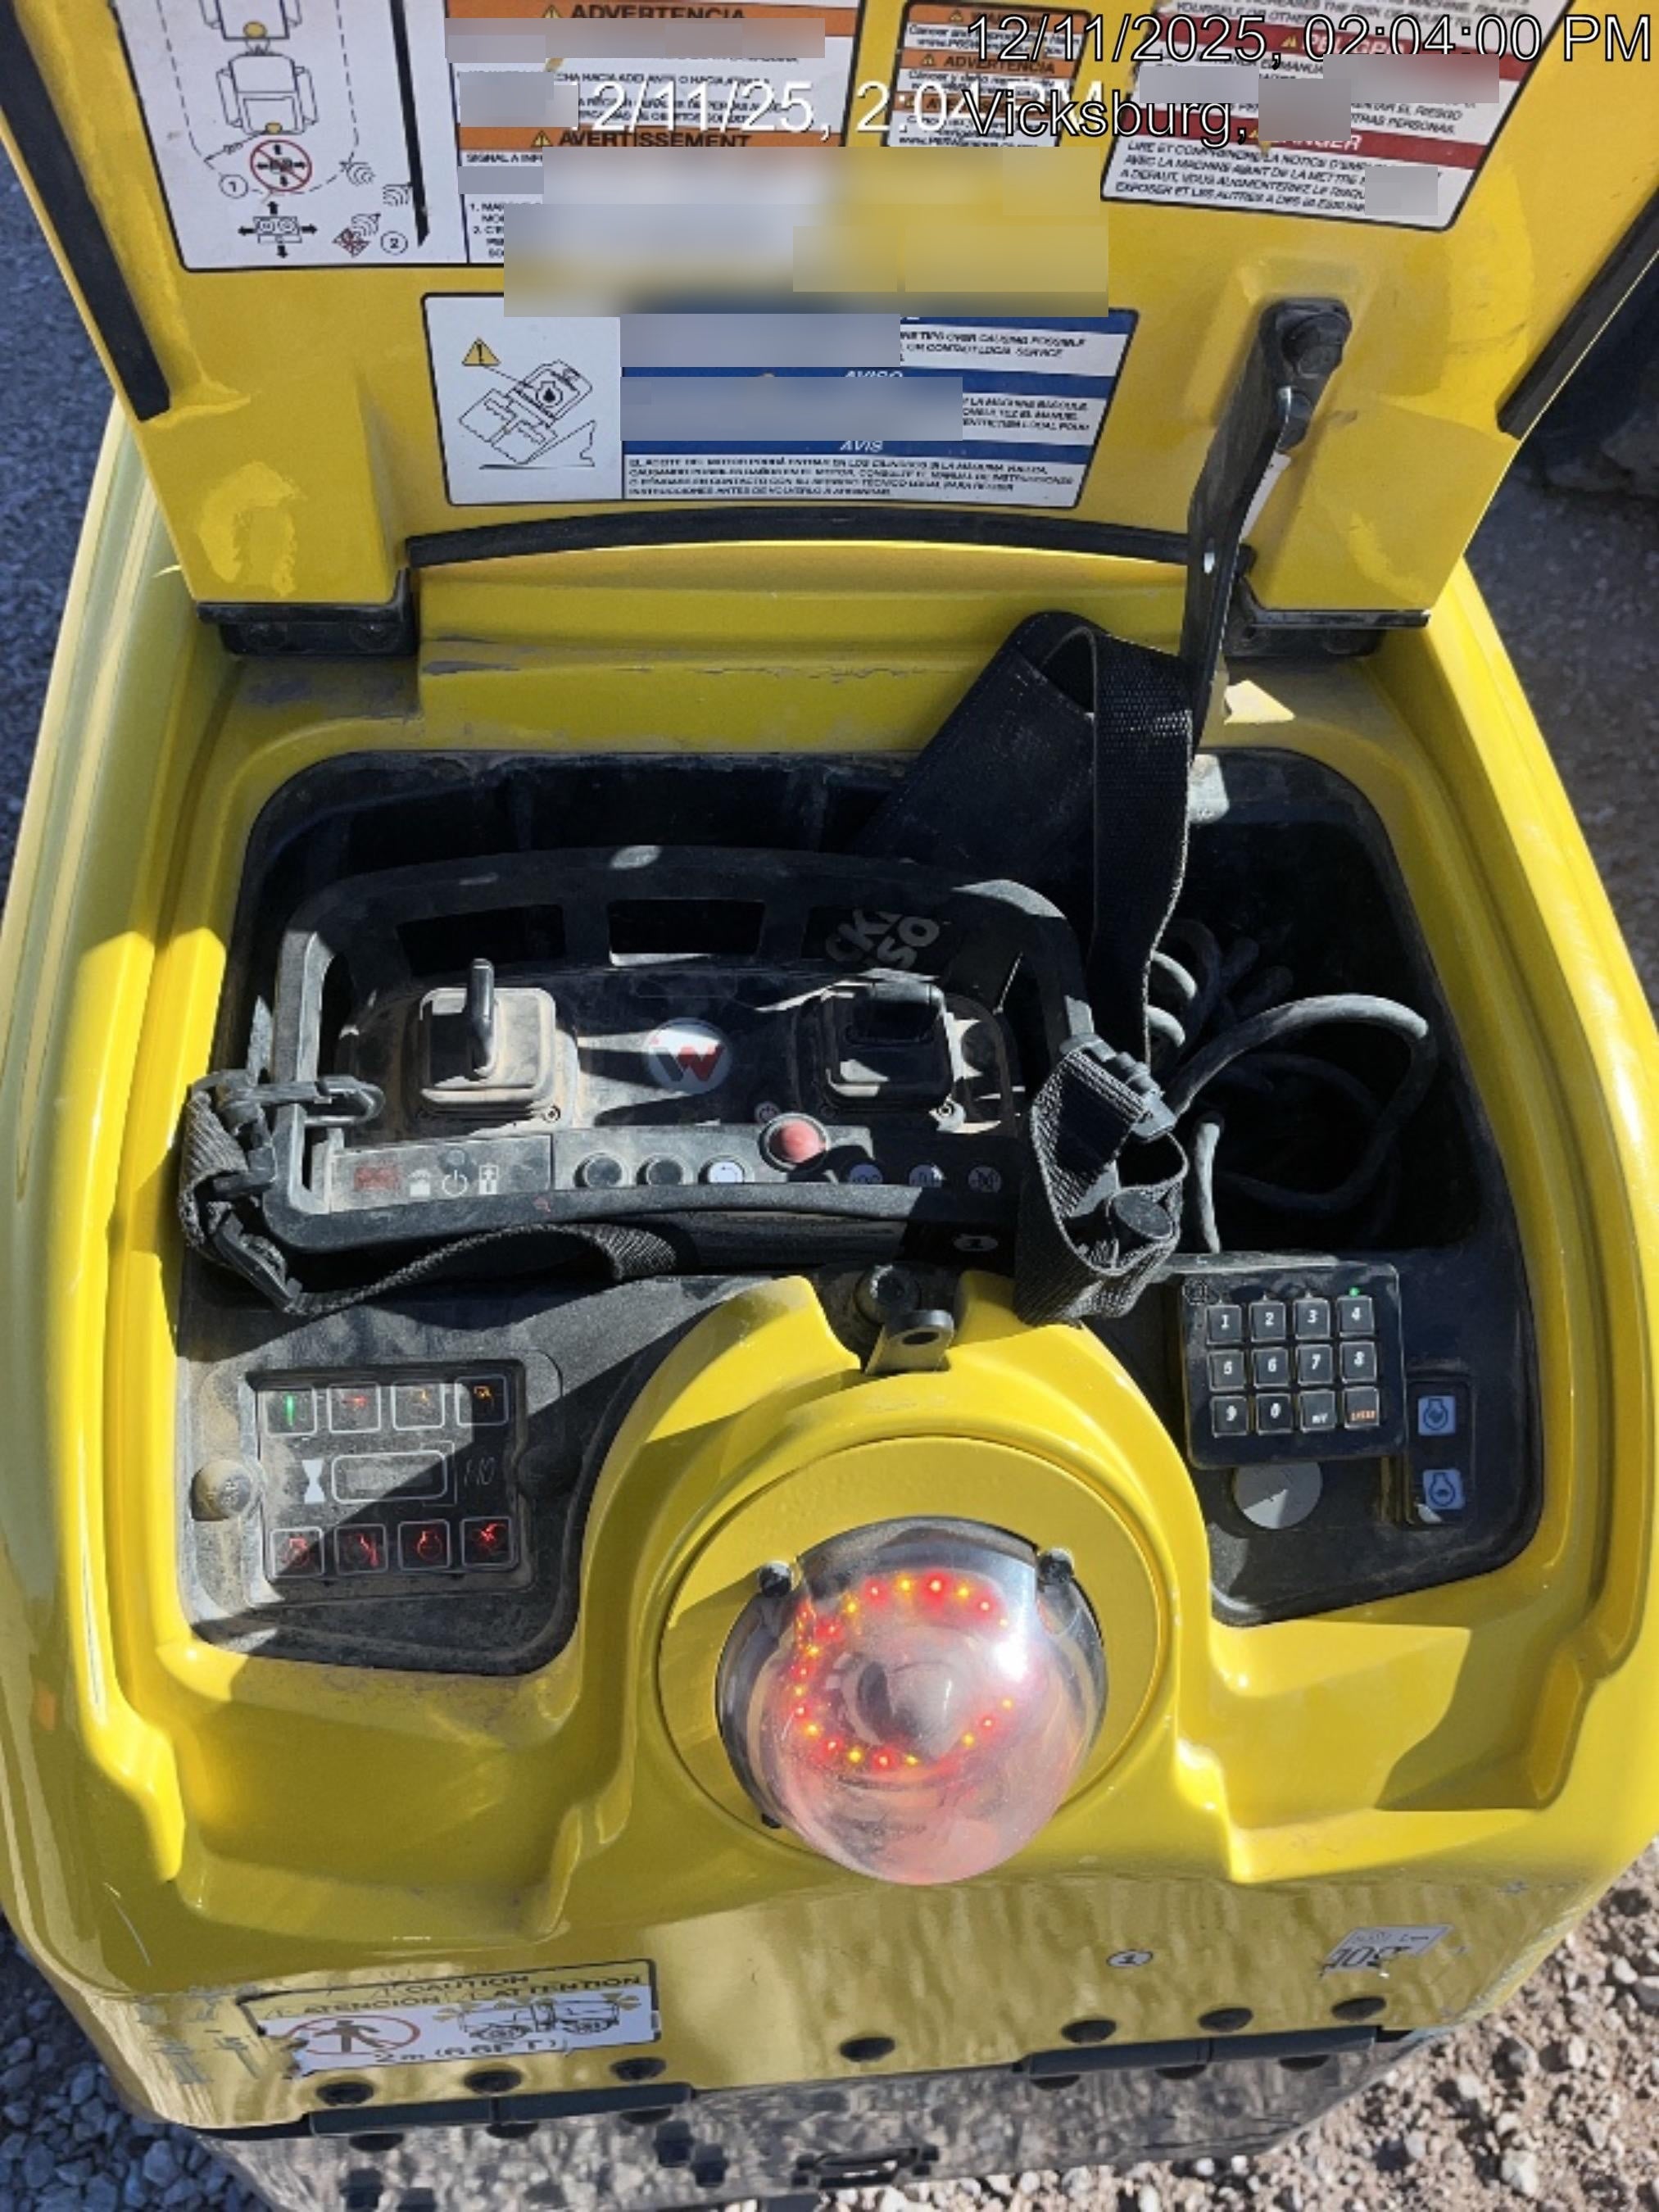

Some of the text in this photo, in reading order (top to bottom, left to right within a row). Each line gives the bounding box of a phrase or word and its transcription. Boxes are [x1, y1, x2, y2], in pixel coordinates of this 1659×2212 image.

[944, 55, 1055, 74] ADVERTENCIA
[559, 130, 750, 146] AVERTISSEMENT
[839, 440, 884, 453] AVIS
[1221, 1307, 1361, 1330] 1 2 3 4
[1223, 1351, 1365, 1376] 5 6 7 8
[1226, 1402, 1280, 1421] 9 0
[406, 1975, 528, 1993] CAUTION
[494, 1975, 640, 1997] ATTENTION
